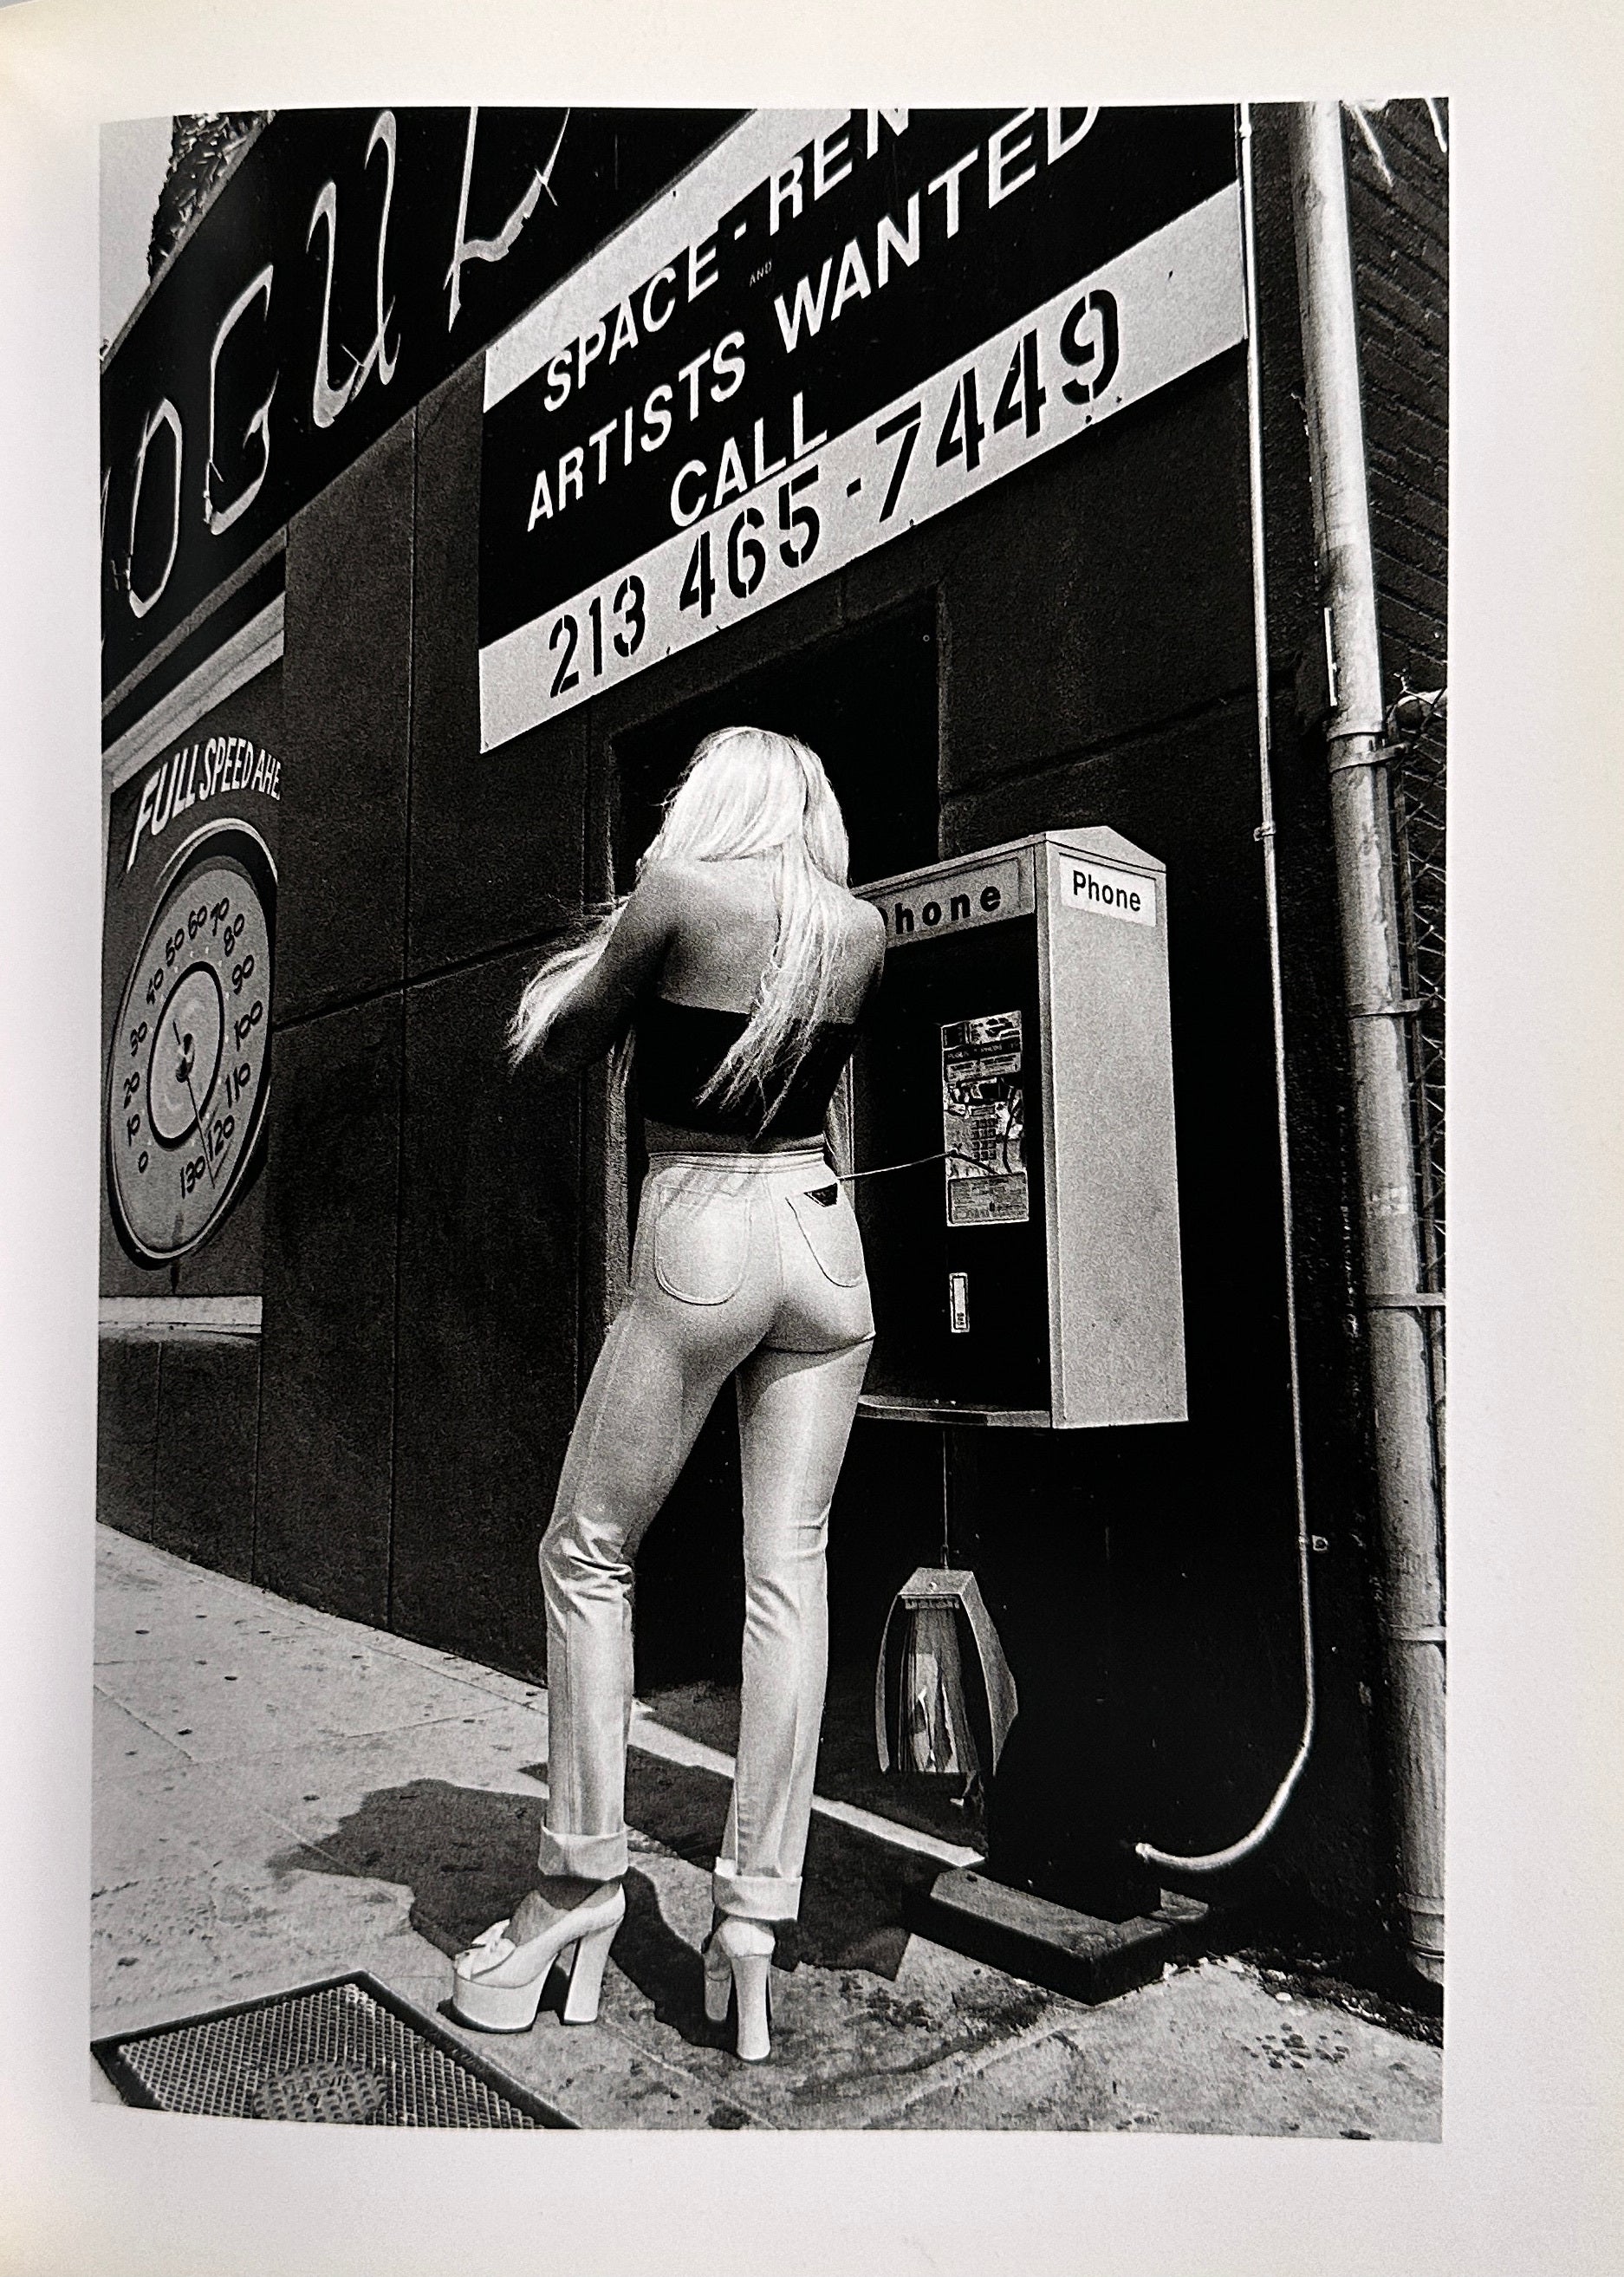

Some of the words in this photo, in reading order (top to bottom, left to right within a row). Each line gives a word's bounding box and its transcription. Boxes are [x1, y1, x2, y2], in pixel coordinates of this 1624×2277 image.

[750, 259, 771, 287] AND
[527, 332, 744, 532] ARTISTS
[774, 107, 1099, 353] WANTED
[669, 393, 828, 527] CALL
[549, 576, 646, 698] 213
[127, 745, 199, 874] FULL
[199, 737, 254, 801] SPEED
[250, 748, 282, 801] AHE
[1073, 870, 1140, 911] Phone
[188, 906, 207, 940] 60
[211, 897, 229, 936] 70
[224, 914, 244, 957] 80
[166, 928, 185, 966] 50
[146, 968, 164, 1005] 40
[232, 954, 255, 995] 90
[130, 1022, 147, 1057] 30
[234, 1000, 263, 1051] 100
[124, 1071, 140, 1109] 20
[225, 1063, 250, 1109] 110
[127, 1114, 140, 1147] 10
[208, 1115, 235, 1161] 120
[138, 1151, 148, 1173] 0
[180, 1155, 205, 1199] 130
